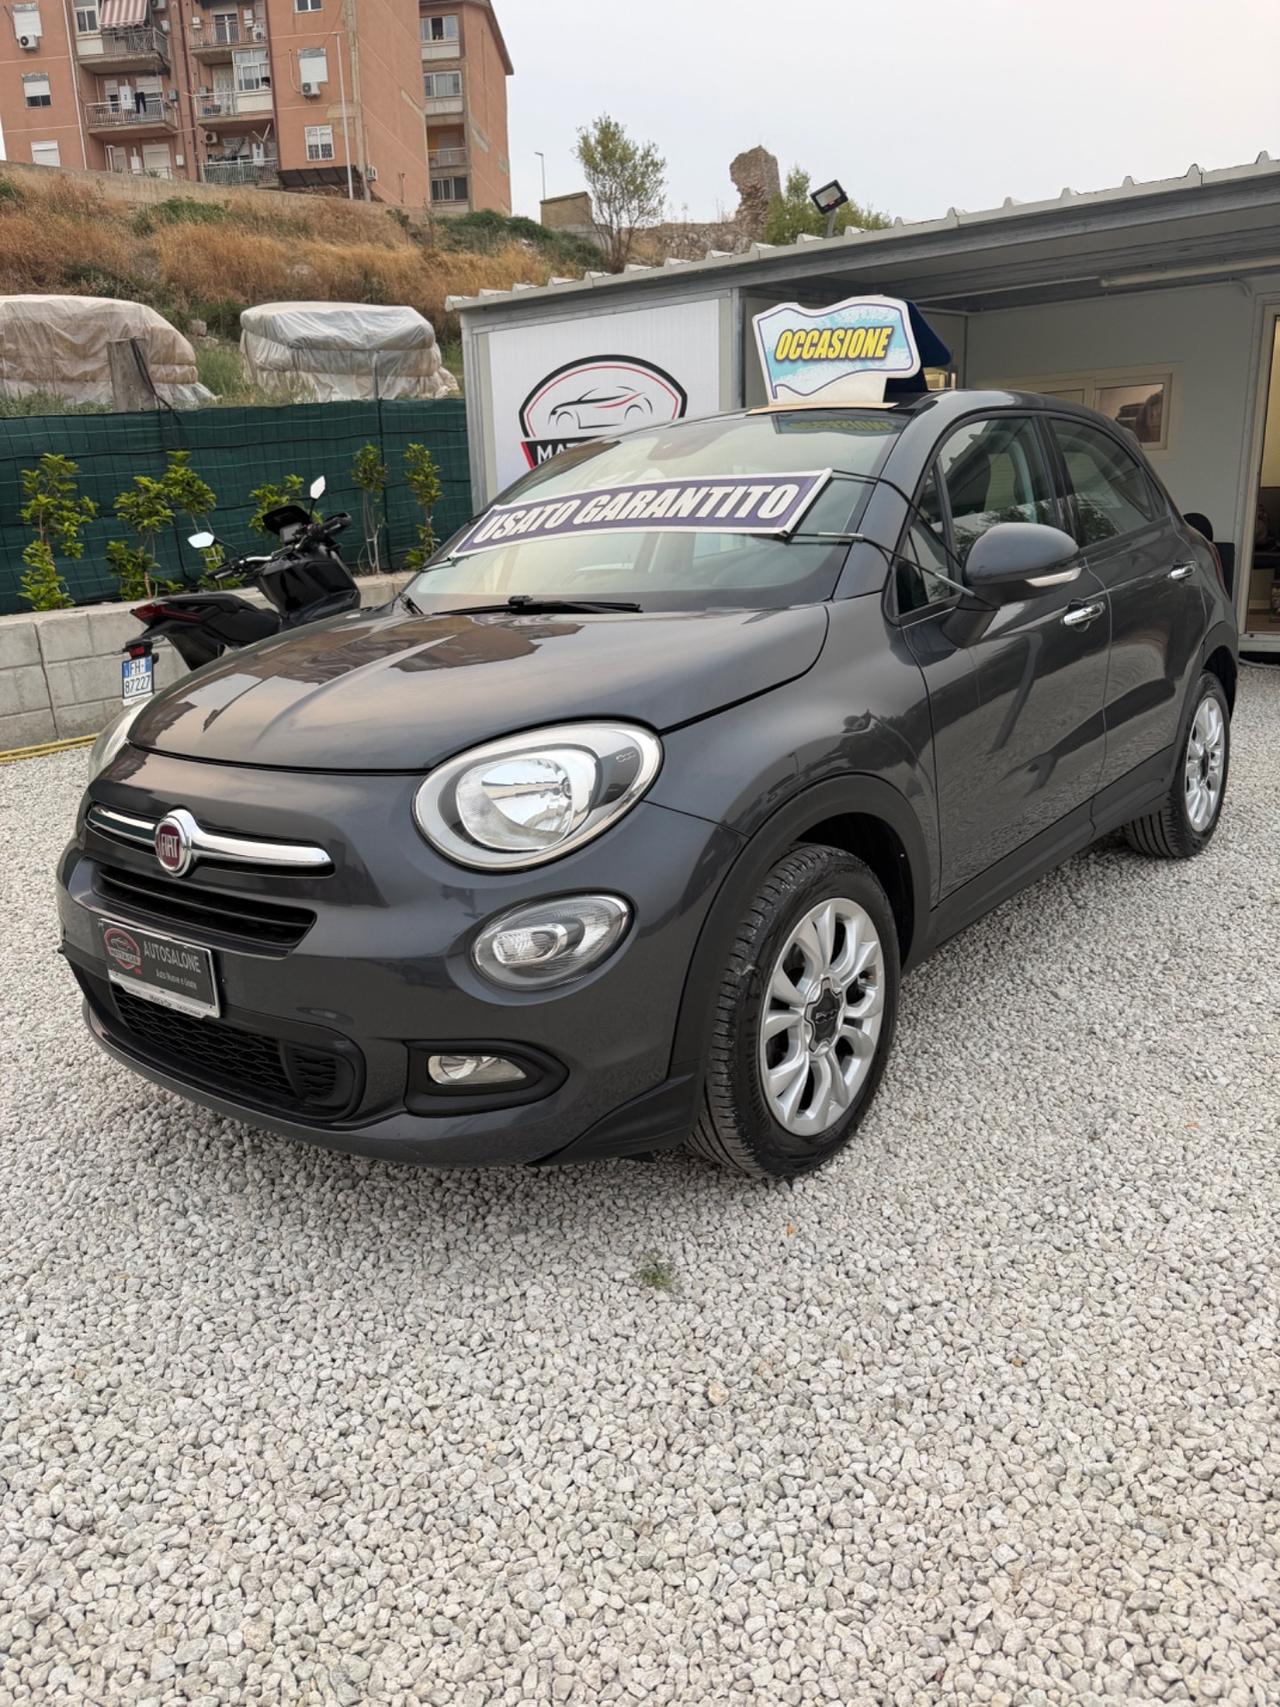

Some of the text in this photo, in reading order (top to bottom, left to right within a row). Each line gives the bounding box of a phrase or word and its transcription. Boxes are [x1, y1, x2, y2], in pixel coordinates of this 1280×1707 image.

[775, 326, 894, 361] OCCASIONE
[473, 483, 800, 545] USATO GARANTITO
[160, 833, 179, 858] FIAT
[143, 940, 202, 974] AUTOSALONE
